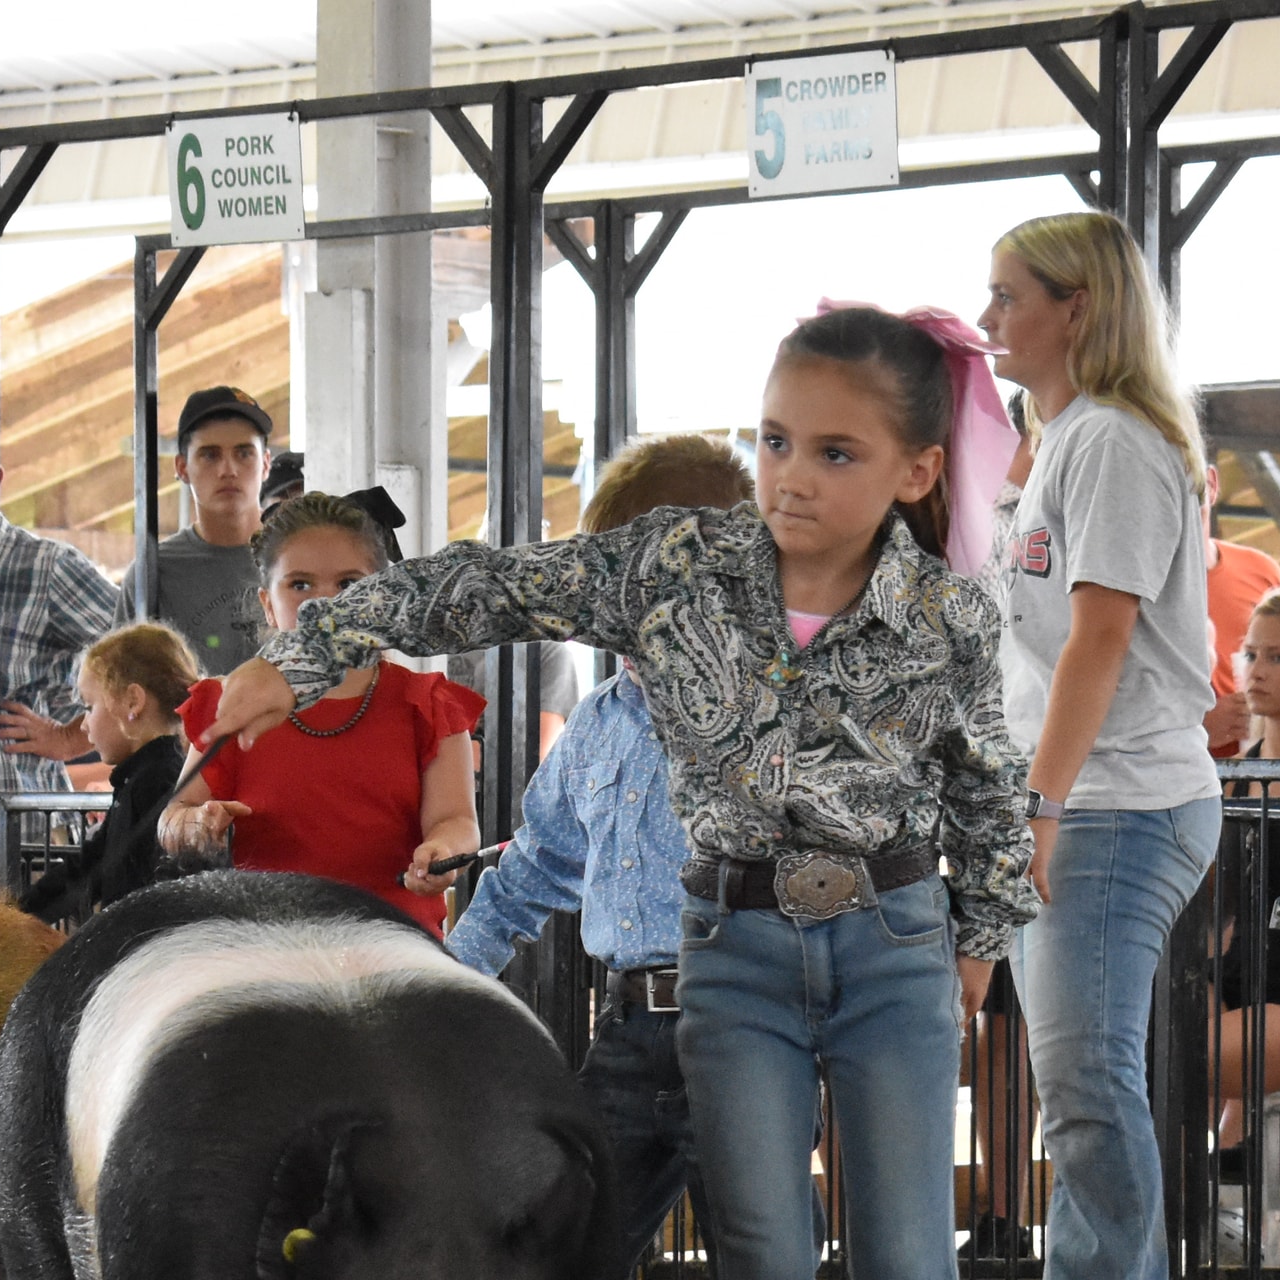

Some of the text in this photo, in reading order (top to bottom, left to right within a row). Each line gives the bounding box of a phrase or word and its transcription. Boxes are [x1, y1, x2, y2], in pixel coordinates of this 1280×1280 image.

[785, 71, 888, 103] CROWDER
[754, 77, 786, 180] 5
[225, 134, 275, 157] PORK
[177, 132, 206, 231] 6
[211, 164, 292, 189] COUNCIL
[217, 195, 287, 219] WOMEN
